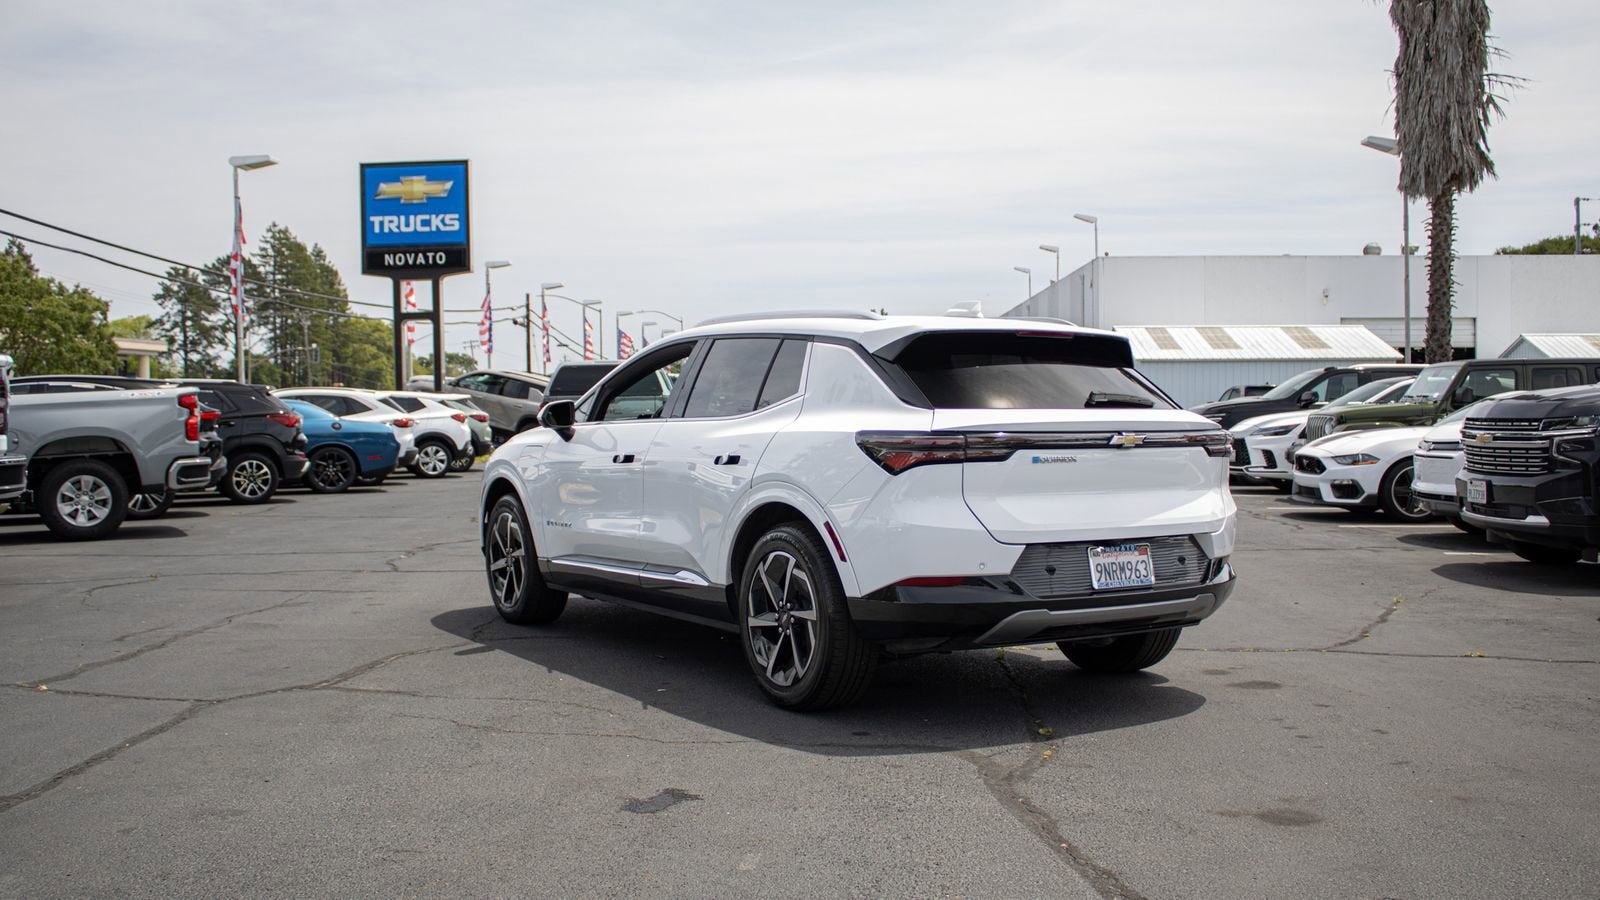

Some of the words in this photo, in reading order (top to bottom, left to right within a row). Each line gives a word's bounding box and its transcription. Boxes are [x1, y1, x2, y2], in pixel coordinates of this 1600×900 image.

[369, 213, 460, 234] TRUCKS
[384, 251, 447, 266] NOVATO
[1095, 559, 1149, 583] 9NRM963
